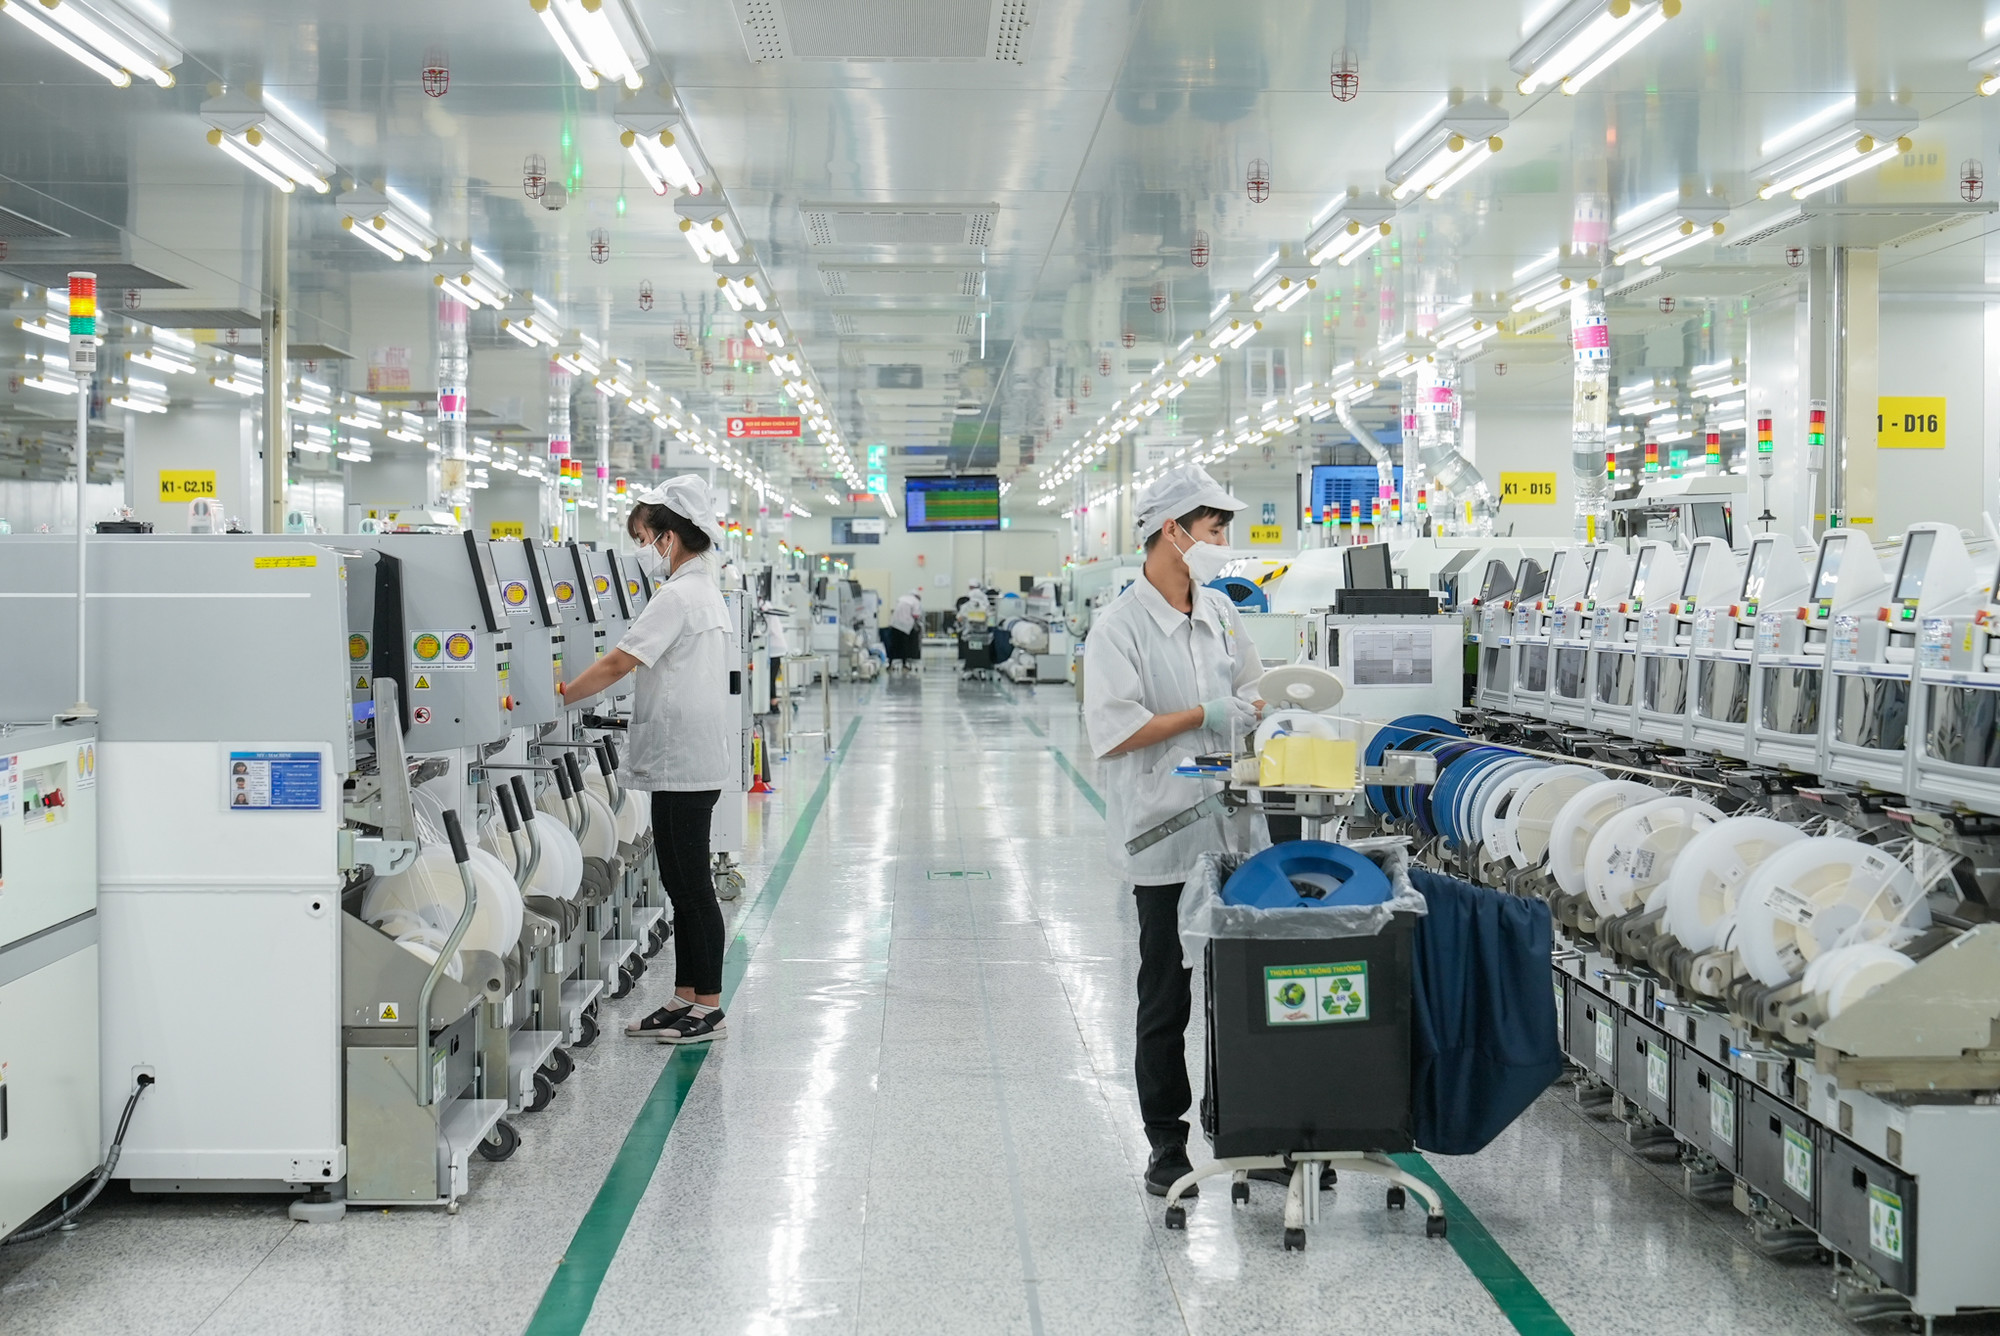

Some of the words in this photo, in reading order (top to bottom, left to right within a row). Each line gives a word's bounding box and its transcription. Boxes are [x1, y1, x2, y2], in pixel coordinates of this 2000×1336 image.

[1904, 414, 1938, 433] D16
[162, 480, 174, 492] K1
[184, 480, 213, 493] C2.15
[1504, 483, 1517, 494] K1
[1531, 483, 1552, 495] D15
[1309, 965, 1331, 974] THÔNG
